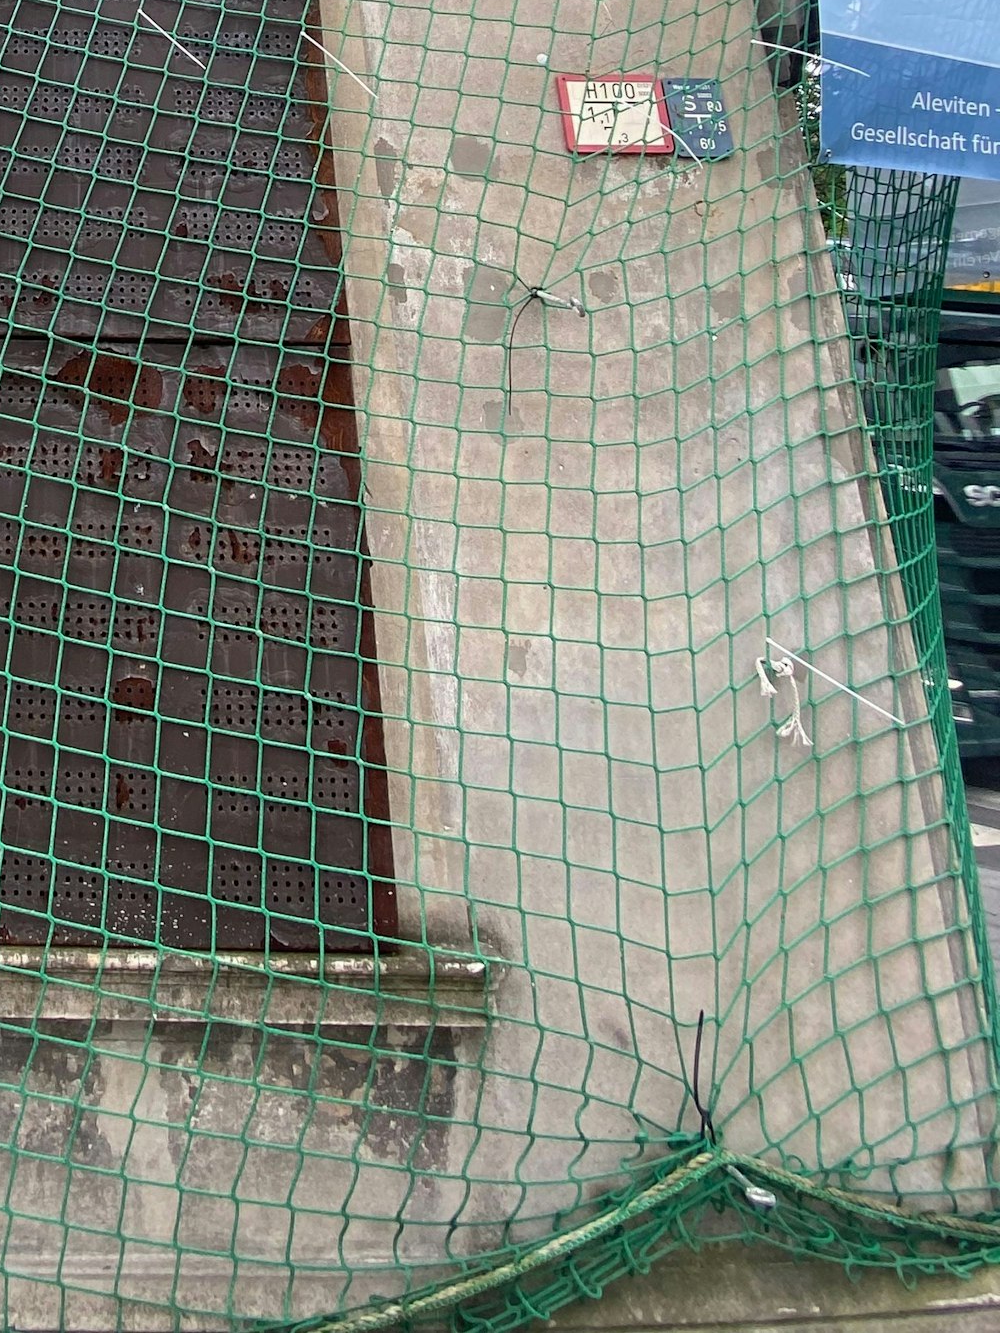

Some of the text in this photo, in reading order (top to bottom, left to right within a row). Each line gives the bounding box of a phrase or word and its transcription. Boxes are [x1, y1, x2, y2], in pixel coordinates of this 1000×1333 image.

[911, 91, 991, 118] Aleviten
[850, 121, 1000, 155] Gesellschaft für
